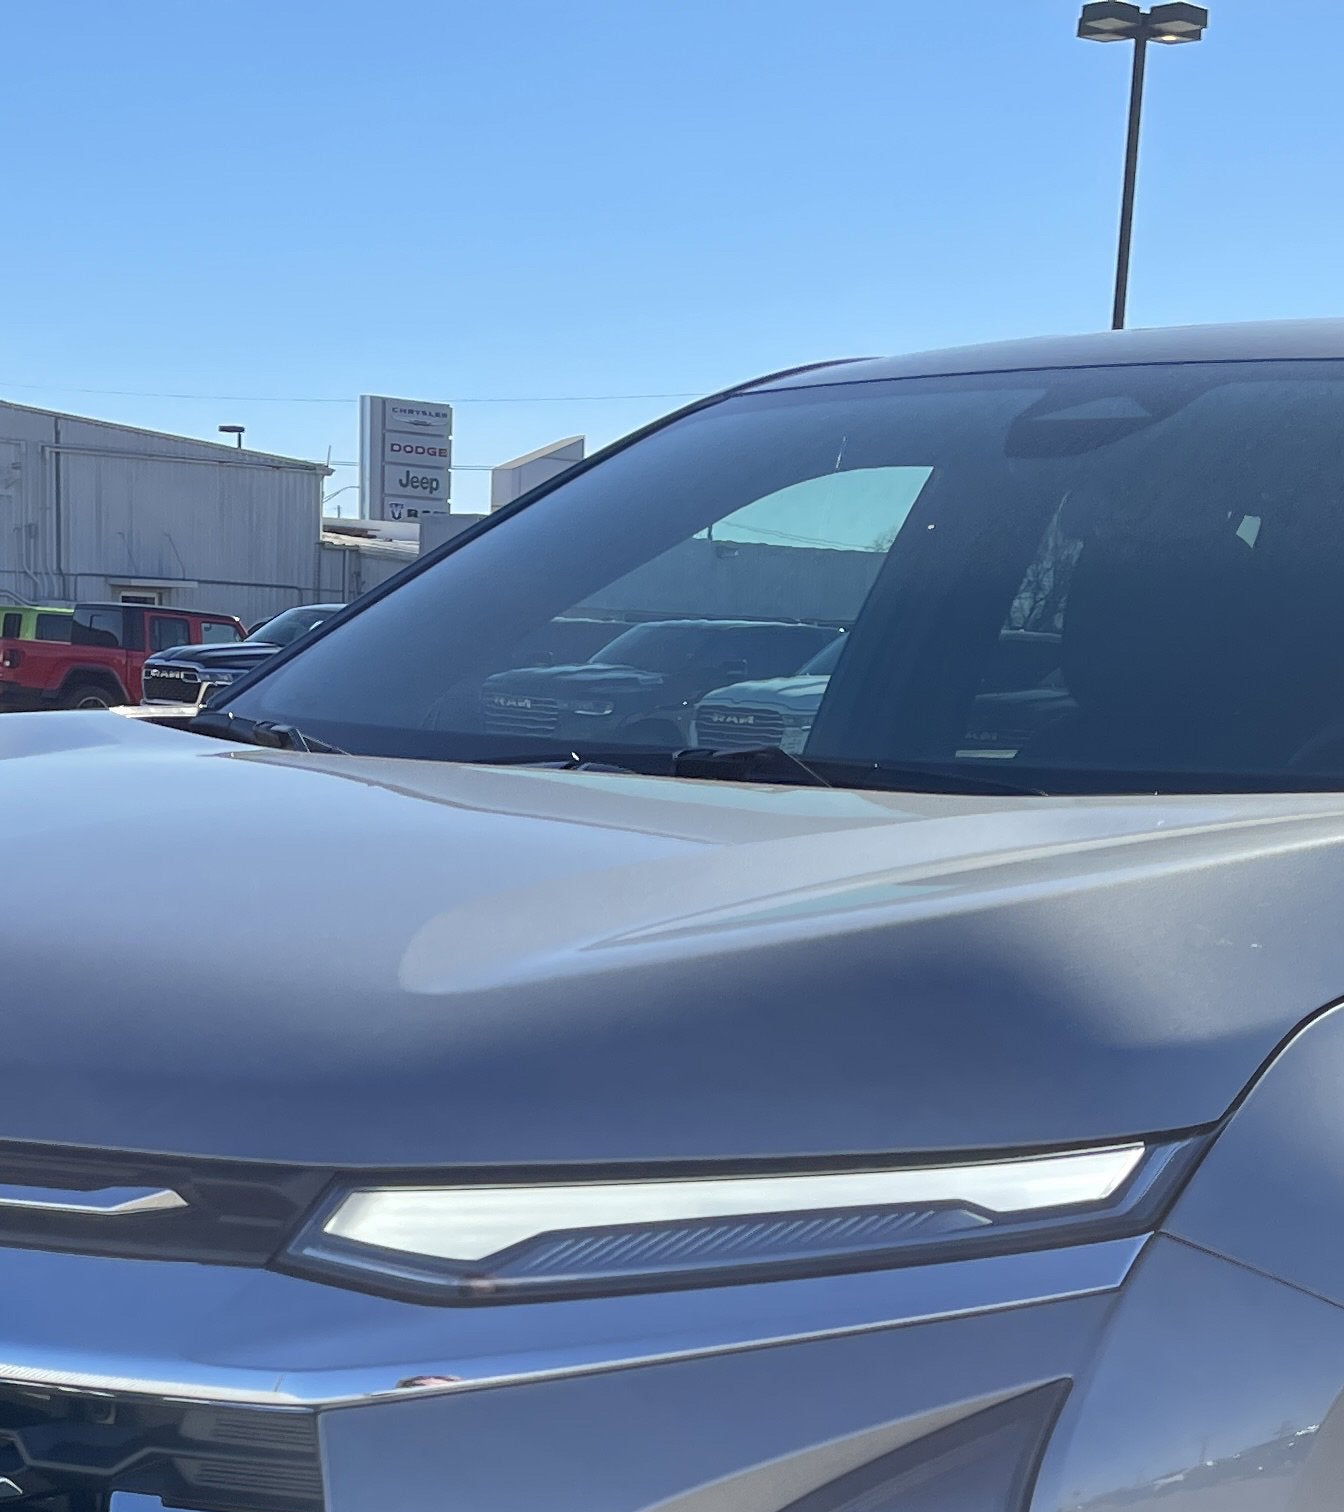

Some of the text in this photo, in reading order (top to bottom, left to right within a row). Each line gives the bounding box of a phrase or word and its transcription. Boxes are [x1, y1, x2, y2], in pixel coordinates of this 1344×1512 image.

[391, 406, 449, 419] CHRYSLER
[390, 442, 449, 458] DODGE
[398, 469, 440, 495] Jeep
